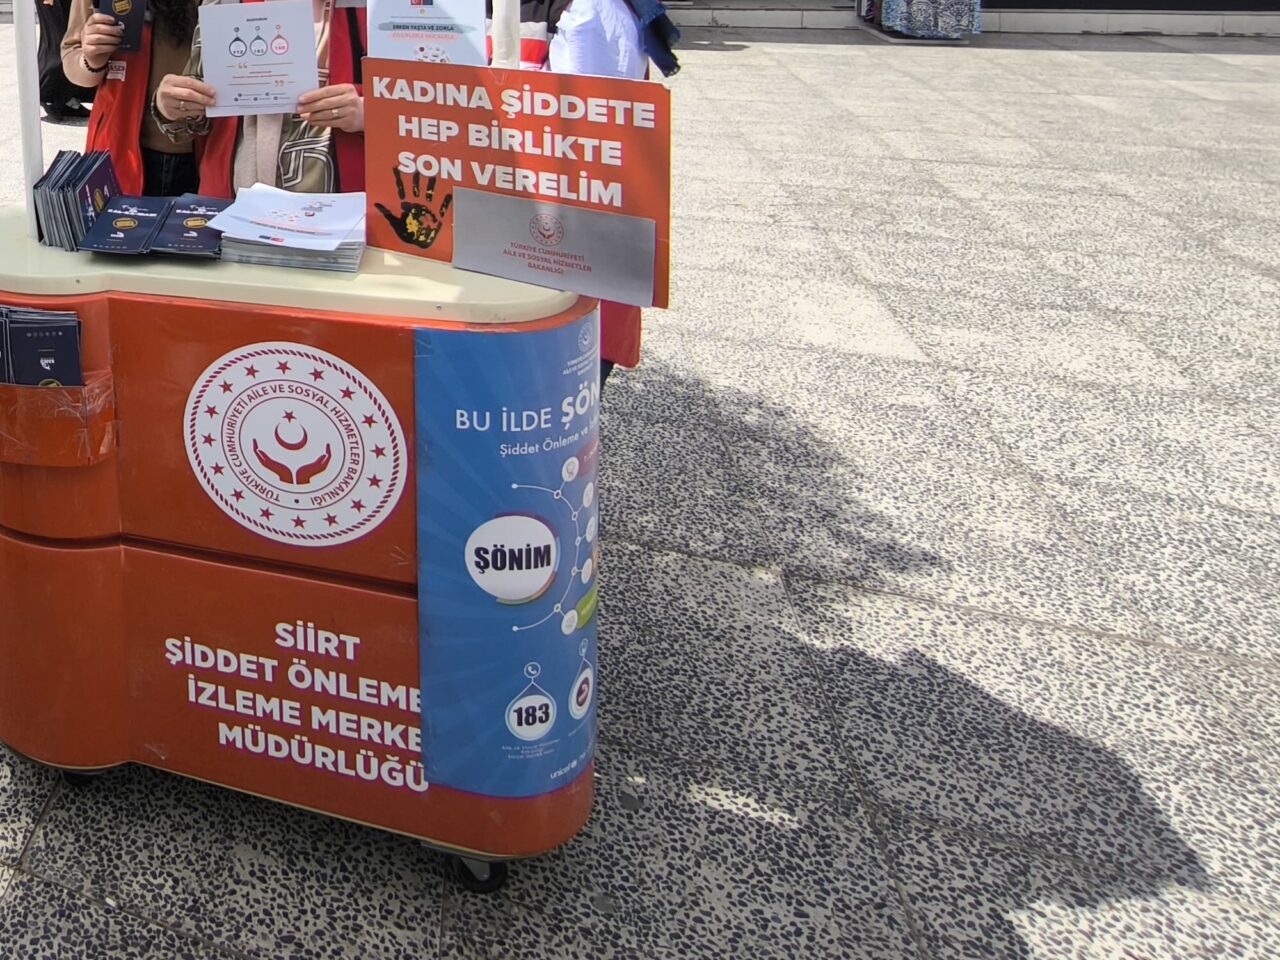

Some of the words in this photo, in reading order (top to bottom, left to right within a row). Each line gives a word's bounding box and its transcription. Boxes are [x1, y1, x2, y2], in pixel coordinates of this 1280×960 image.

[372, 76, 493, 110] KADINA
[500, 85, 655, 128] ŞİDDETE
[398, 115, 459, 142] HEP
[468, 120, 622, 166] BİRLİKTE
[398, 151, 462, 181] SON
[470, 161, 622, 207] VERELİM
[510, 242, 537, 253] TÜRKİYE
[247, 385, 269, 402] AİLE
[269, 384, 286, 394] VE
[288, 384, 330, 409] SOSYAL
[226, 397, 249, 468] CUMHURİYETİ
[330, 405, 360, 466] HİZMETLER
[455, 409, 491, 431] BU
[502, 407, 552, 432] İLDE
[500, 444, 539, 458] Şiddet
[543, 432, 579, 452] Önleme
[239, 468, 280, 503] TÜRKİYE
[310, 466, 359, 505] BAKANLIĞI
[474, 544, 551, 574] ŞÖNİM
[275, 620, 360, 660] SİİRT
[164, 636, 278, 682] ŞİDDET
[187, 673, 301, 726] İZLEME
[311, 705, 422, 753] MERKE
[513, 703, 550, 727] 183
[218, 722, 429, 792] MÜDÜRLÜĞÜ
[550, 762, 571, 779] unicef
